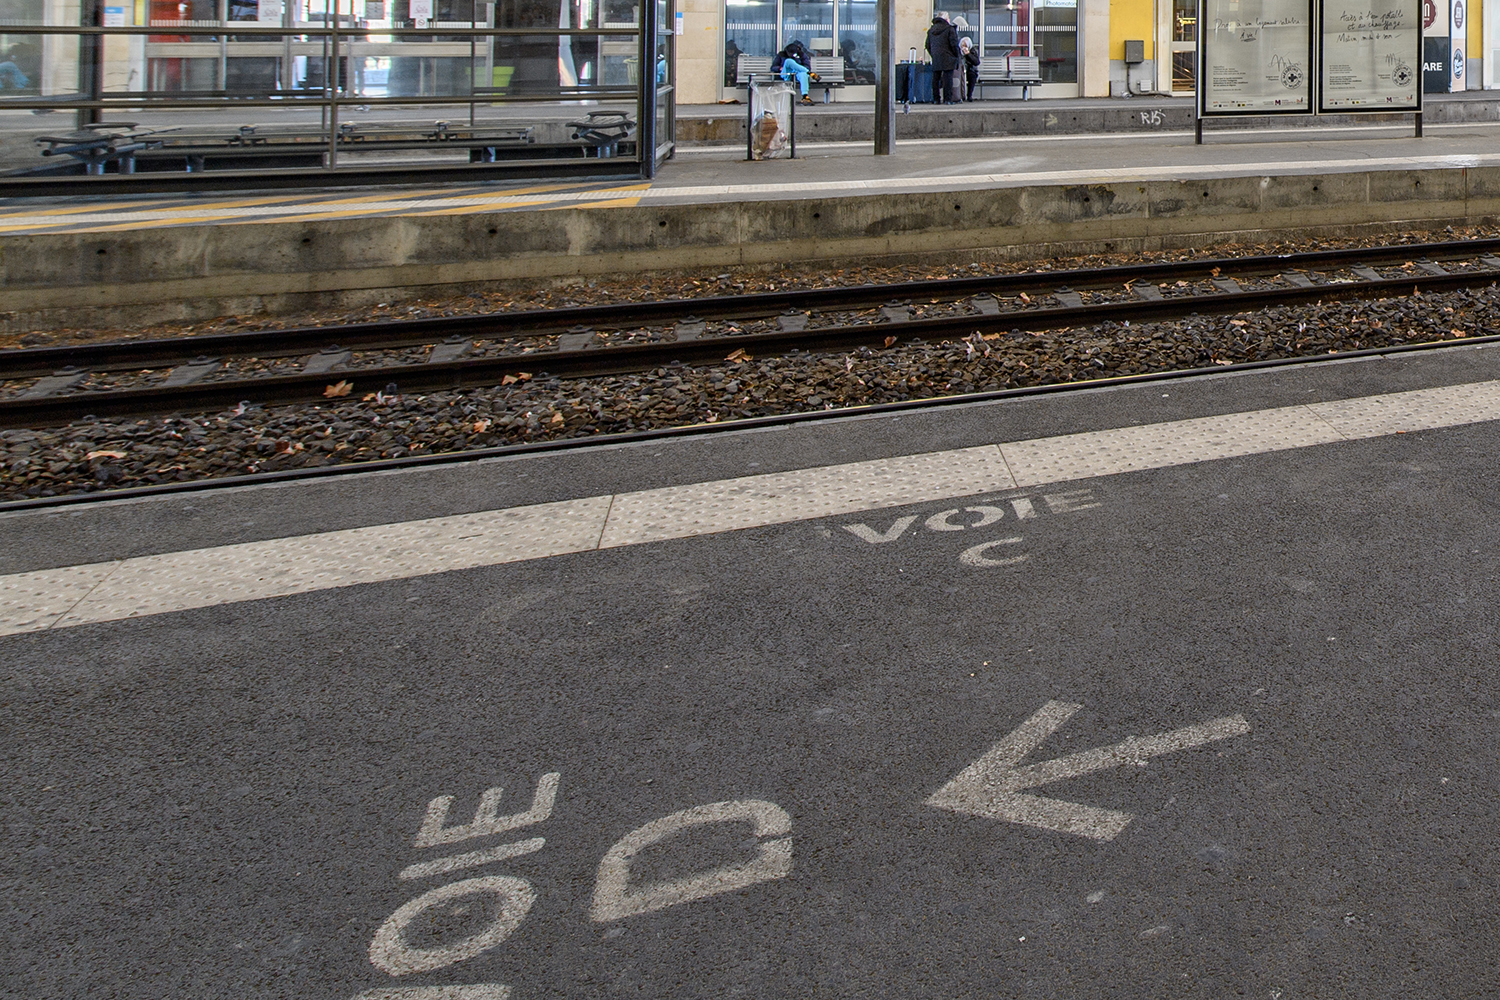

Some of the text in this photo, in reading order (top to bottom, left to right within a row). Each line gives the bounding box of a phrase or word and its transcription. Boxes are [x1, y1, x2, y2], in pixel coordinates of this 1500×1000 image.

[842, 489, 1101, 544] VOIE
[959, 536, 1030, 567] C
[590, 799, 794, 922] D
